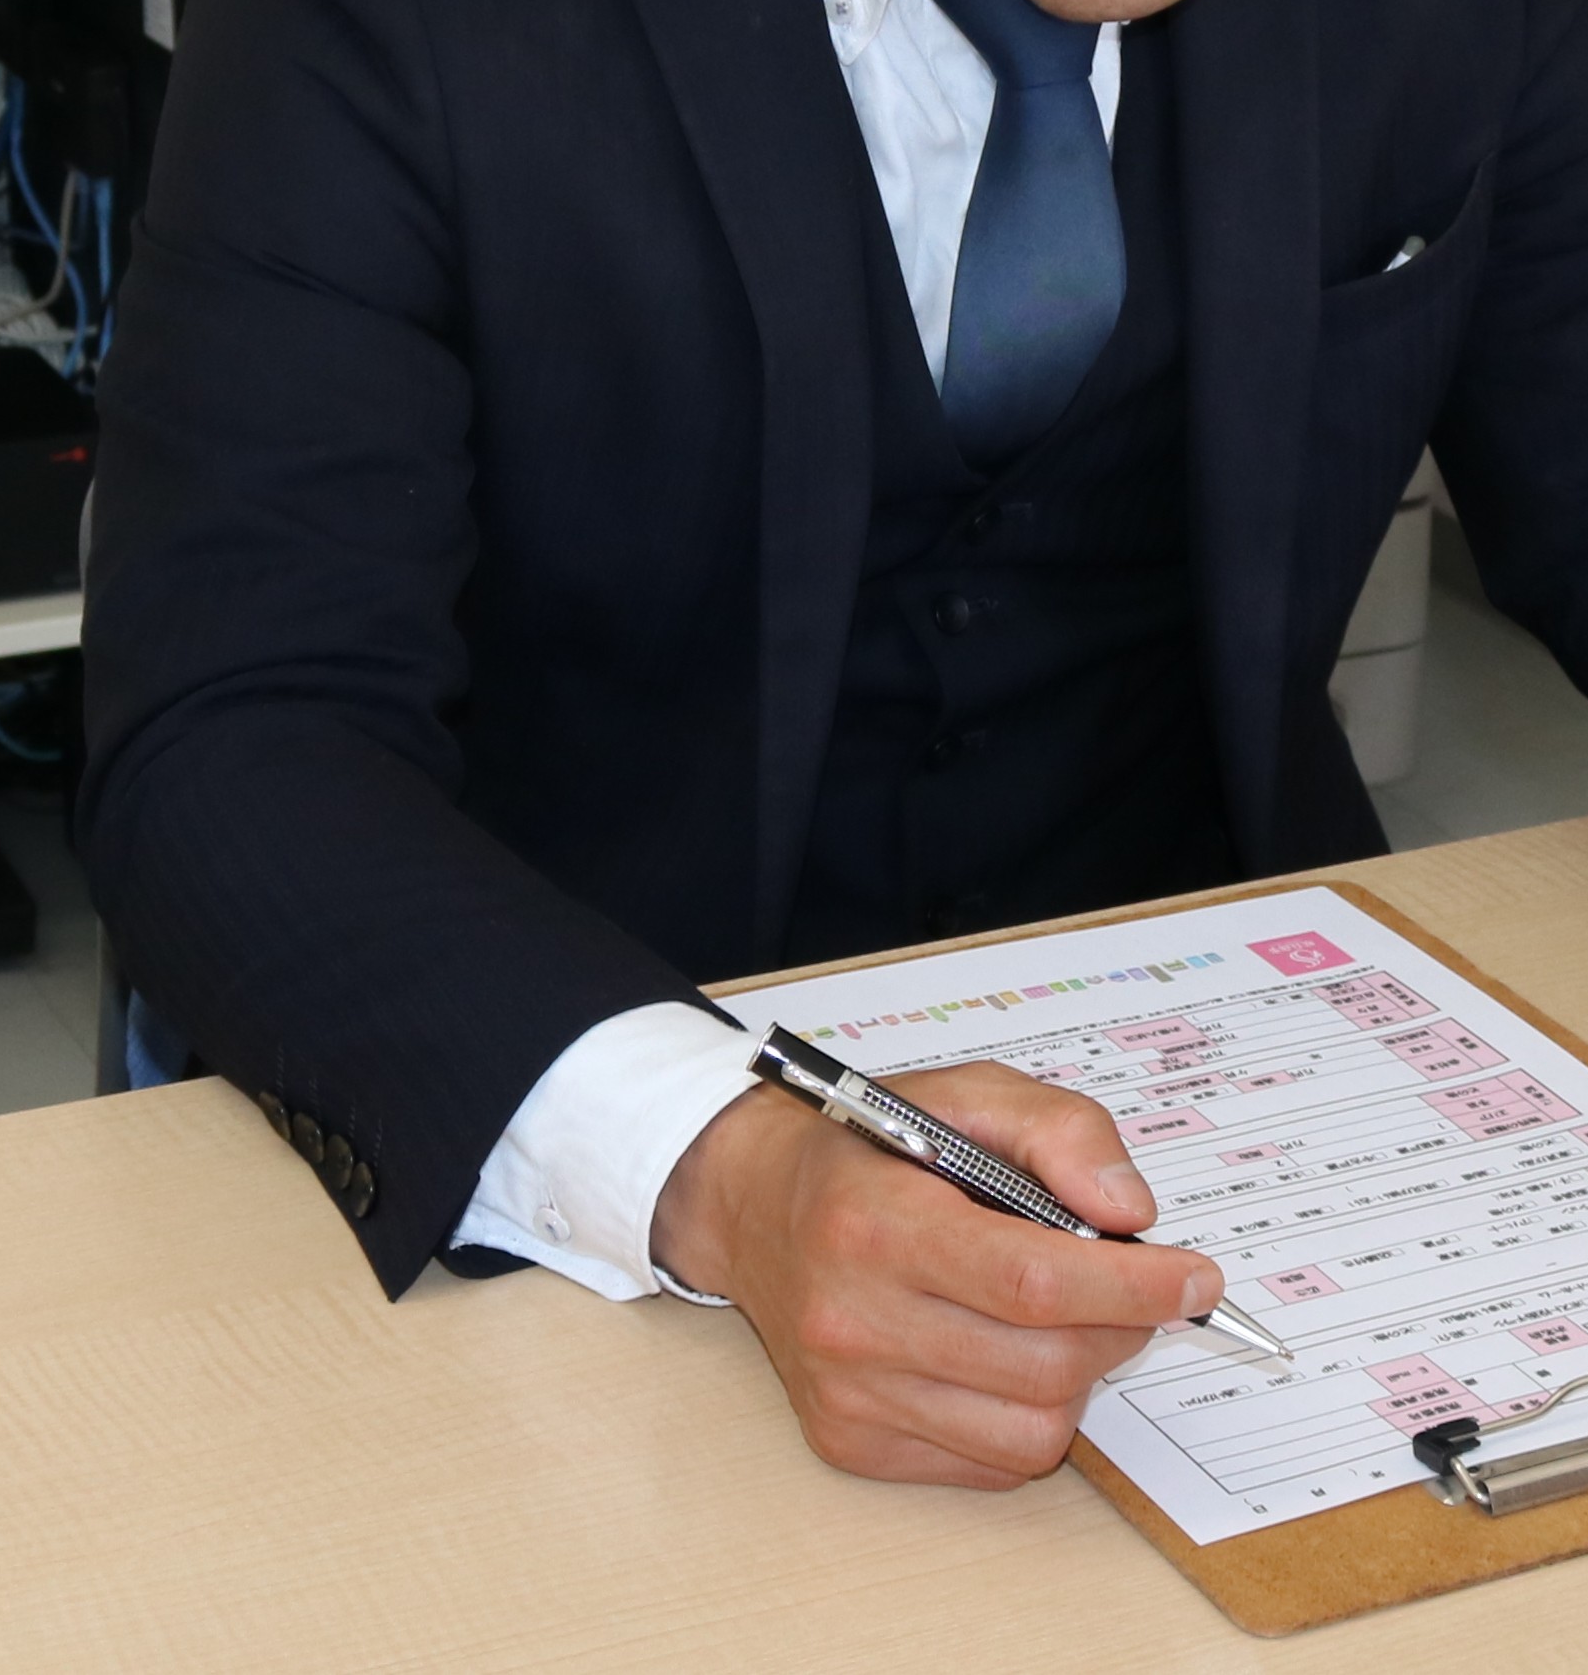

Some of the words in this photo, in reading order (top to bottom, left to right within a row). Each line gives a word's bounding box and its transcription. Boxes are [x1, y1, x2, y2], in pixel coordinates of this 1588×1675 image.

[1488, 1217, 1533, 1232] アパート
[1251, 1504, 1267, 1513] 日
